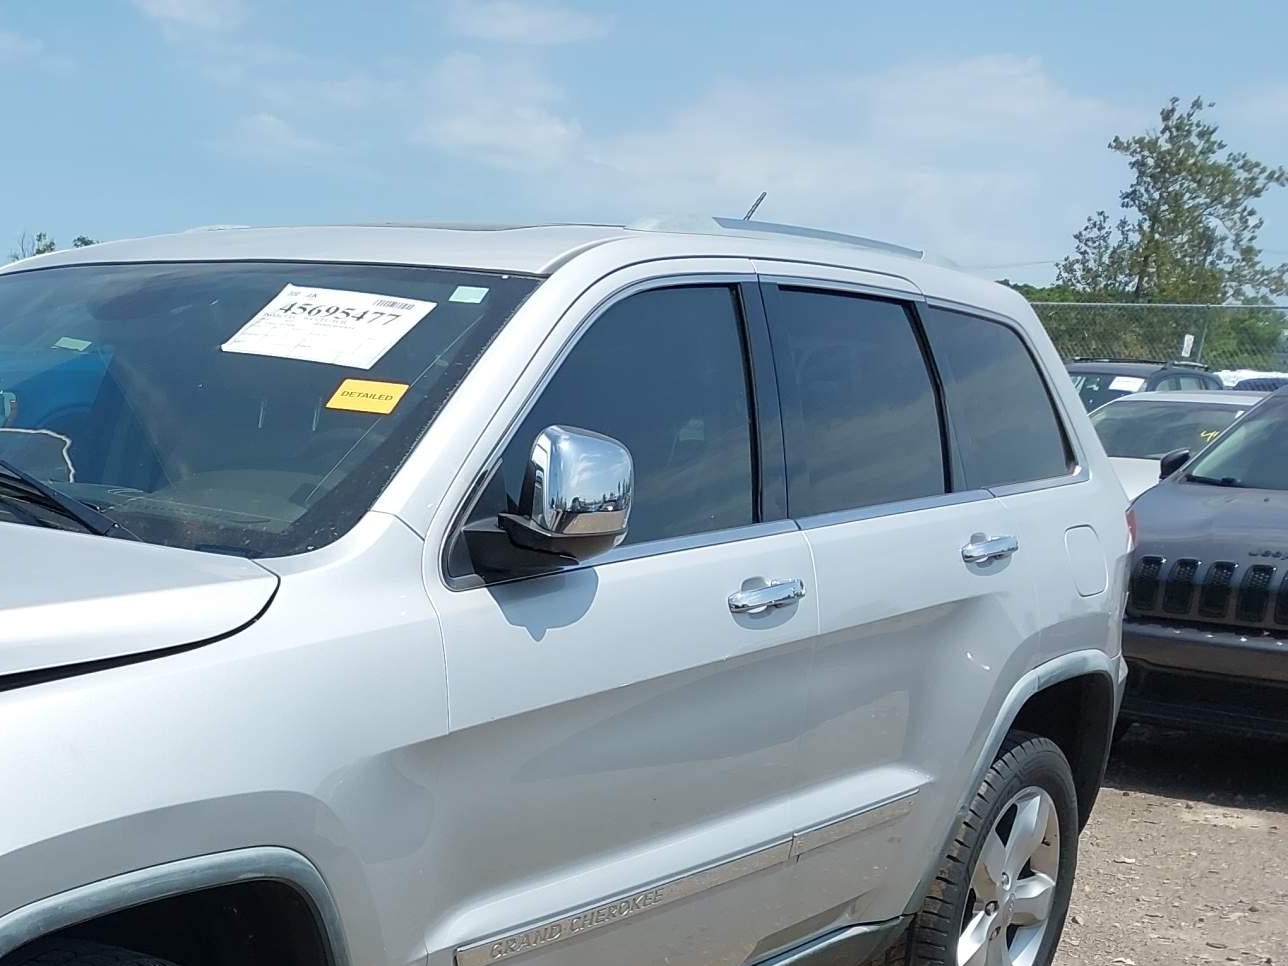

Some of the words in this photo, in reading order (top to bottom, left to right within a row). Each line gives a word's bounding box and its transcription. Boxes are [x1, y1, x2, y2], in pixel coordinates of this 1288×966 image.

[279, 301, 401, 326] 45695477
[340, 390, 394, 401] DETAILED
[489, 923, 562, 960] GRAND
[569, 889, 664, 933] CHEROKEE
